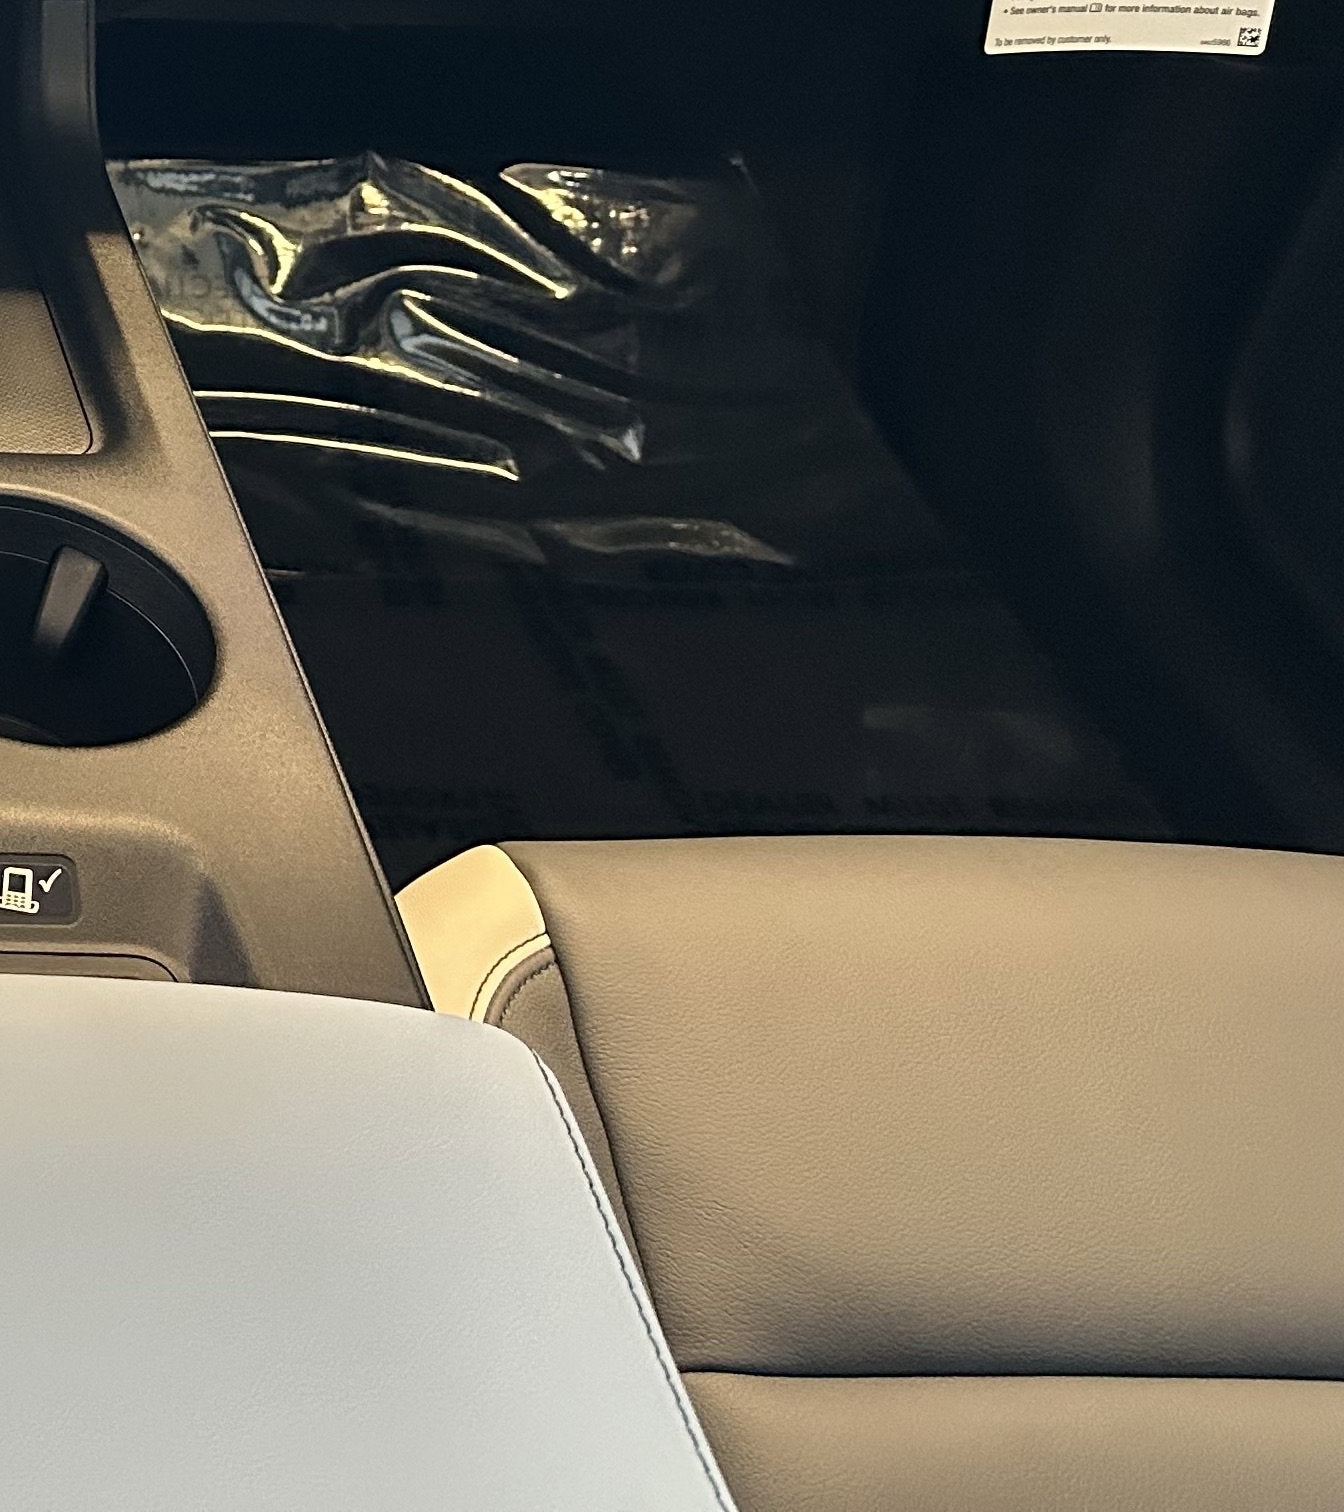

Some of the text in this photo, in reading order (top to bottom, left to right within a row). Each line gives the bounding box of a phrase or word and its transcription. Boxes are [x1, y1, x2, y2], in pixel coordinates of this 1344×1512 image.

[1105, 4, 1117, 12] for
[1118, 5, 1140, 13] more
[1142, 4, 1192, 13] information
[1193, 6, 1219, 15] about
[1220, 7, 1234, 16] air
